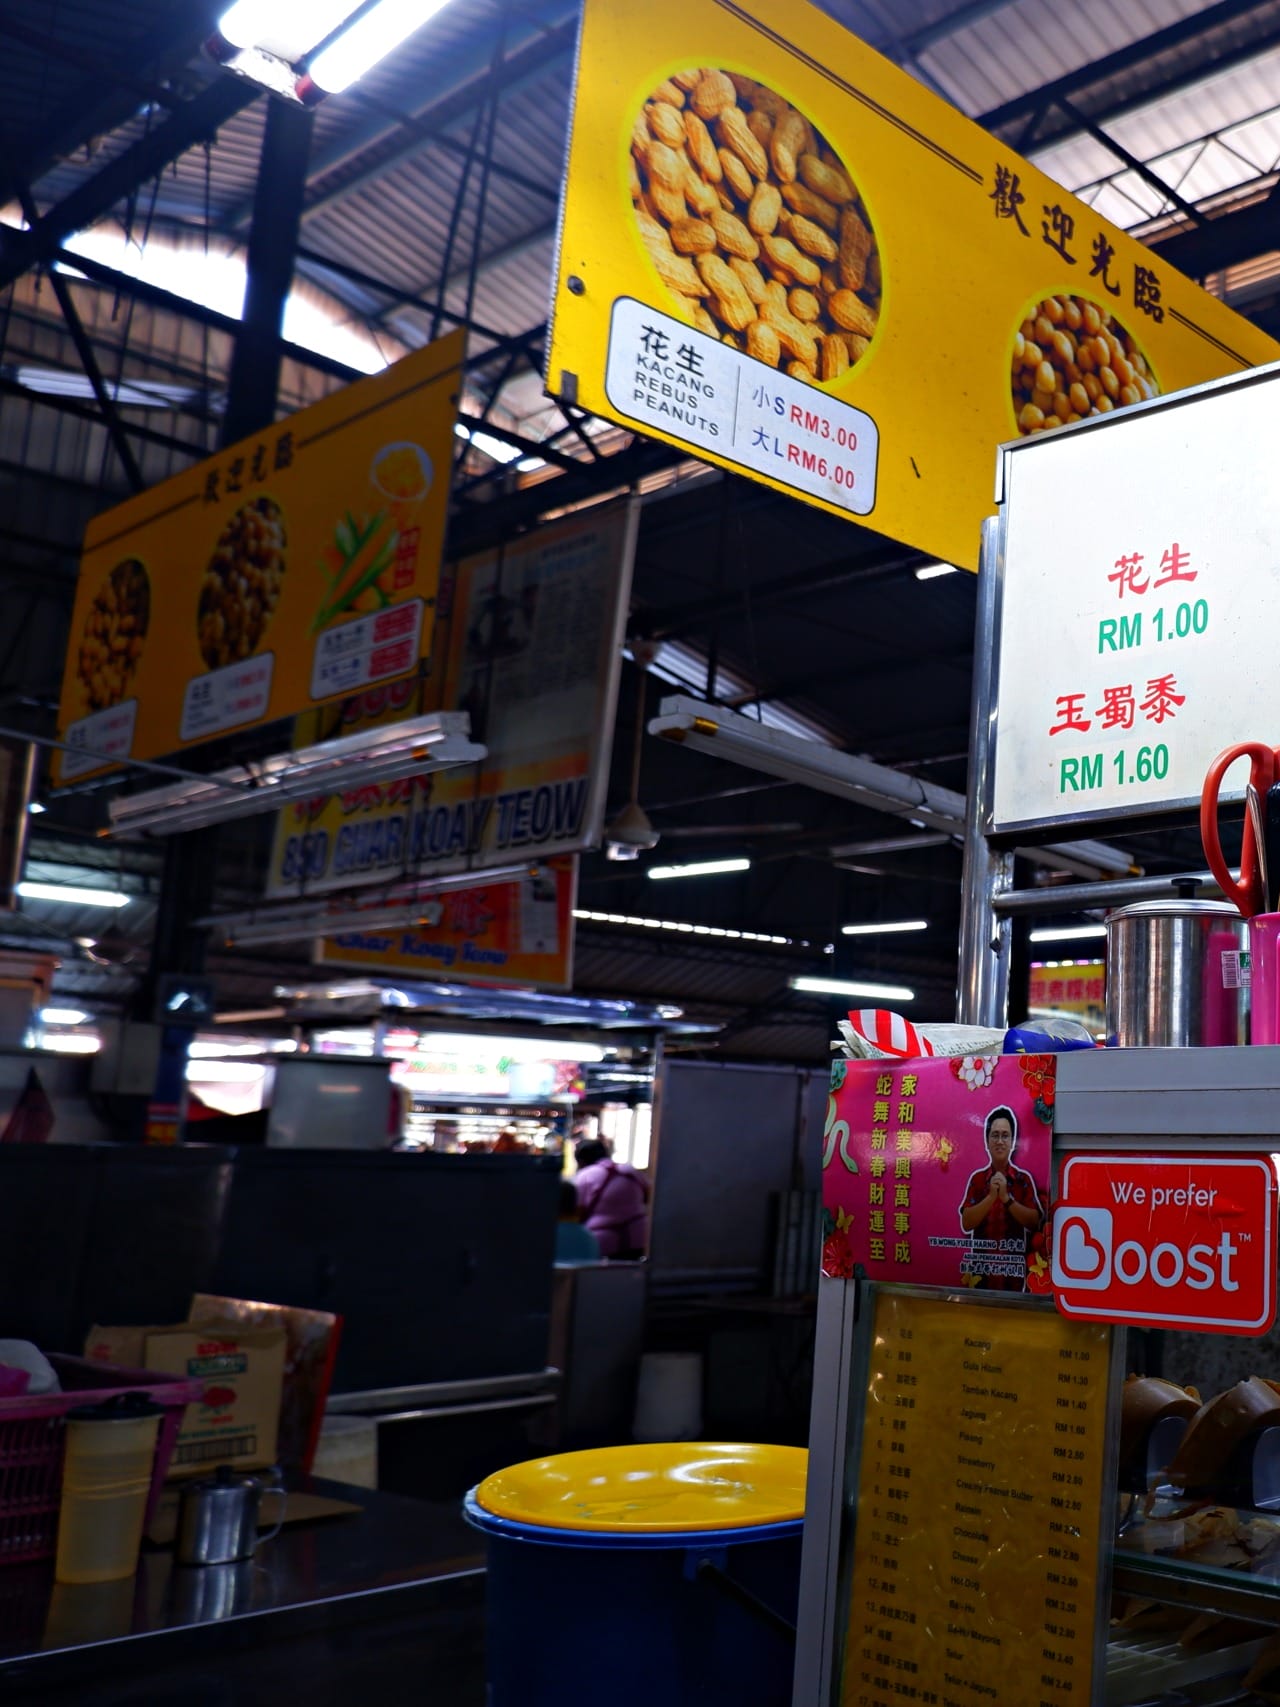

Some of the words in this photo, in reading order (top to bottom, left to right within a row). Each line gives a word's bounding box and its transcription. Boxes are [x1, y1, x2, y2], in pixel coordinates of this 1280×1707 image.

[989, 162, 1166, 324] 歡迎光臨
[637, 354, 715, 399] KACANG
[639, 324, 704, 378] 花生
[633, 389, 720, 436] PEANUTS
[635, 371, 698, 409] REBUS
[790, 405, 858, 451] RM3.00
[787, 443, 855, 489] RM6.00
[1107, 543, 1198, 599] 花生
[1098, 613, 1143, 654] RM
[1152, 598, 1209, 641] 1.00
[1048, 673, 1187, 737] 玉蜀黍
[1060, 753, 1104, 793] RM
[1113, 743, 1169, 785] 1.60
[497, 779, 588, 846] TEOW
[869, 1074, 893, 1261] 蛇舞新春財運至
[894, 1074, 918, 1264] 家和業興萬事成
[1111, 1182, 1146, 1205] We
[1152, 1183, 1218, 1212] prefer
[1051, 1206, 1240, 1293] Boost
